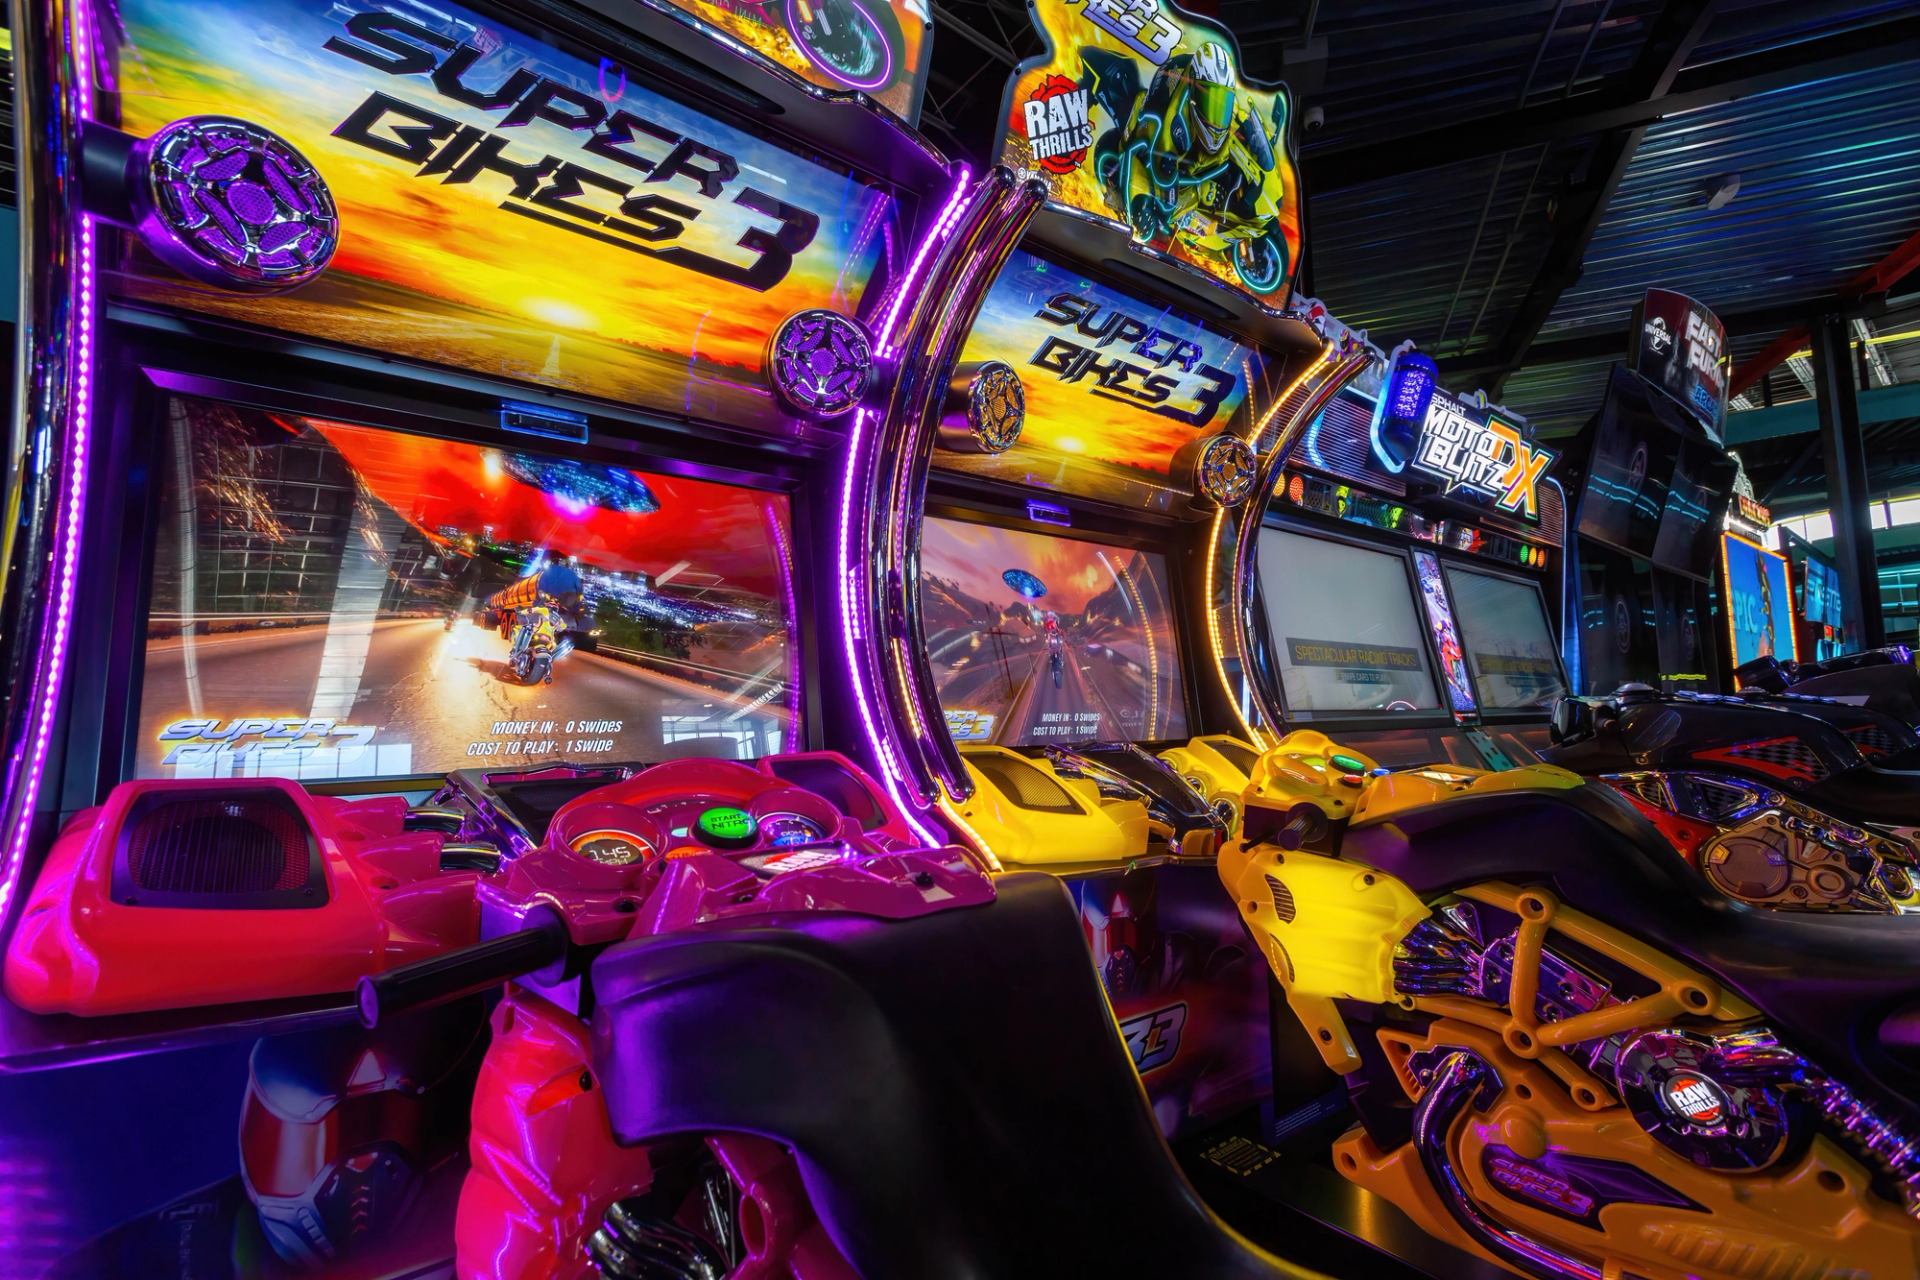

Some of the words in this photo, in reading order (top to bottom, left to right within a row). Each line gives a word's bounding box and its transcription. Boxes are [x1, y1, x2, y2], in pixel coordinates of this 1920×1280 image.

[322, 12, 740, 199] SUPER
[1024, 89, 1088, 138] RAW
[1029, 125, 1093, 160] THRILLS
[330, 90, 702, 242] BIKES
[726, 187, 820, 292] 3
[1034, 292, 1203, 373] SUPER
[1028, 335, 1181, 404] BIKES
[1191, 362, 1236, 428] 3
[1430, 393, 1466, 415] SPHALT
[1424, 404, 1505, 461] MOTO
[1420, 434, 1511, 489] BLITZ
[1295, 645, 1357, 663] SPECTACULAR
[1358, 650, 1388, 665] RACING
[1389, 652, 1416, 667] TRACKS
[159, 719, 336, 741] SUPER
[491, 721, 537, 735] MONEY
[565, 721, 575, 733] 0
[1033, 726, 1048, 736] COST
[1049, 726, 1056, 735] TO
[1042, 713, 1061, 722] MONEY
[467, 741, 502, 756] COST
[506, 741, 521, 755] TO
[566, 740, 572, 752] 1
[710, 813, 741, 823] START
[711, 820, 749, 830] NITRO
[1670, 1081, 1713, 1108] RAW
[1681, 1096, 1720, 1116] THRILLS
[1489, 1158, 1569, 1192] SUPER
[1493, 1169, 1562, 1201] BIKES
